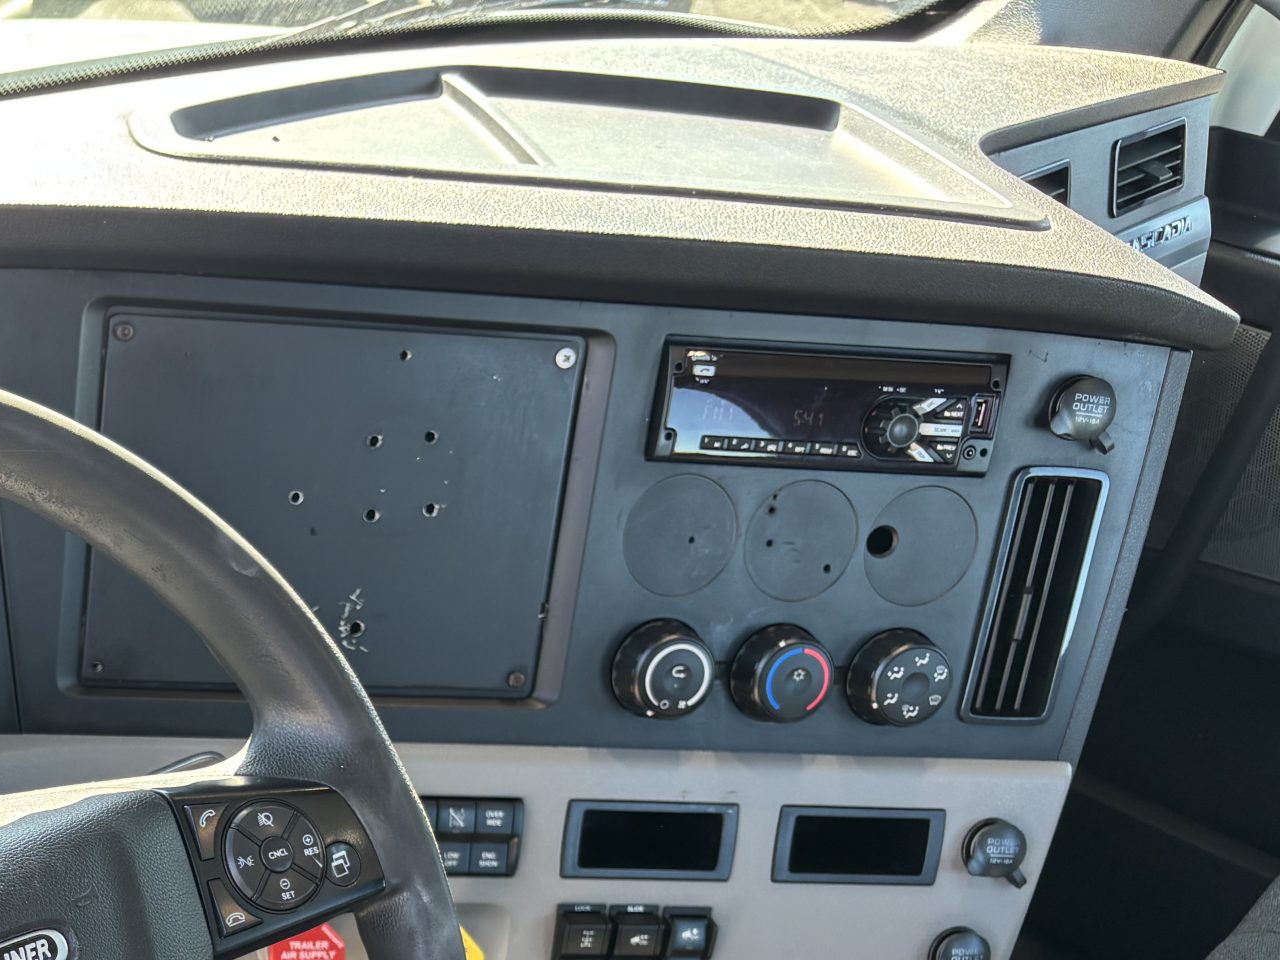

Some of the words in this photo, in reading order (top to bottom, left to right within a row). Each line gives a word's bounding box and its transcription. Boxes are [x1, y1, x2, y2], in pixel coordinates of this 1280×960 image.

[1125, 216, 1192, 252] ASCADIA
[1075, 393, 1110, 405] POWER
[1072, 402, 1109, 414] OUTLET
[987, 837, 1017, 847] POW
[268, 849, 289, 860] CNCL
[304, 846, 319, 857] RES
[281, 890, 295, 900] SET
[289, 940, 329, 950] TRAILER
[281, 951, 297, 960] AIR
[299, 950, 336, 960] SUPPLY
[951, 947, 980, 956] POW
